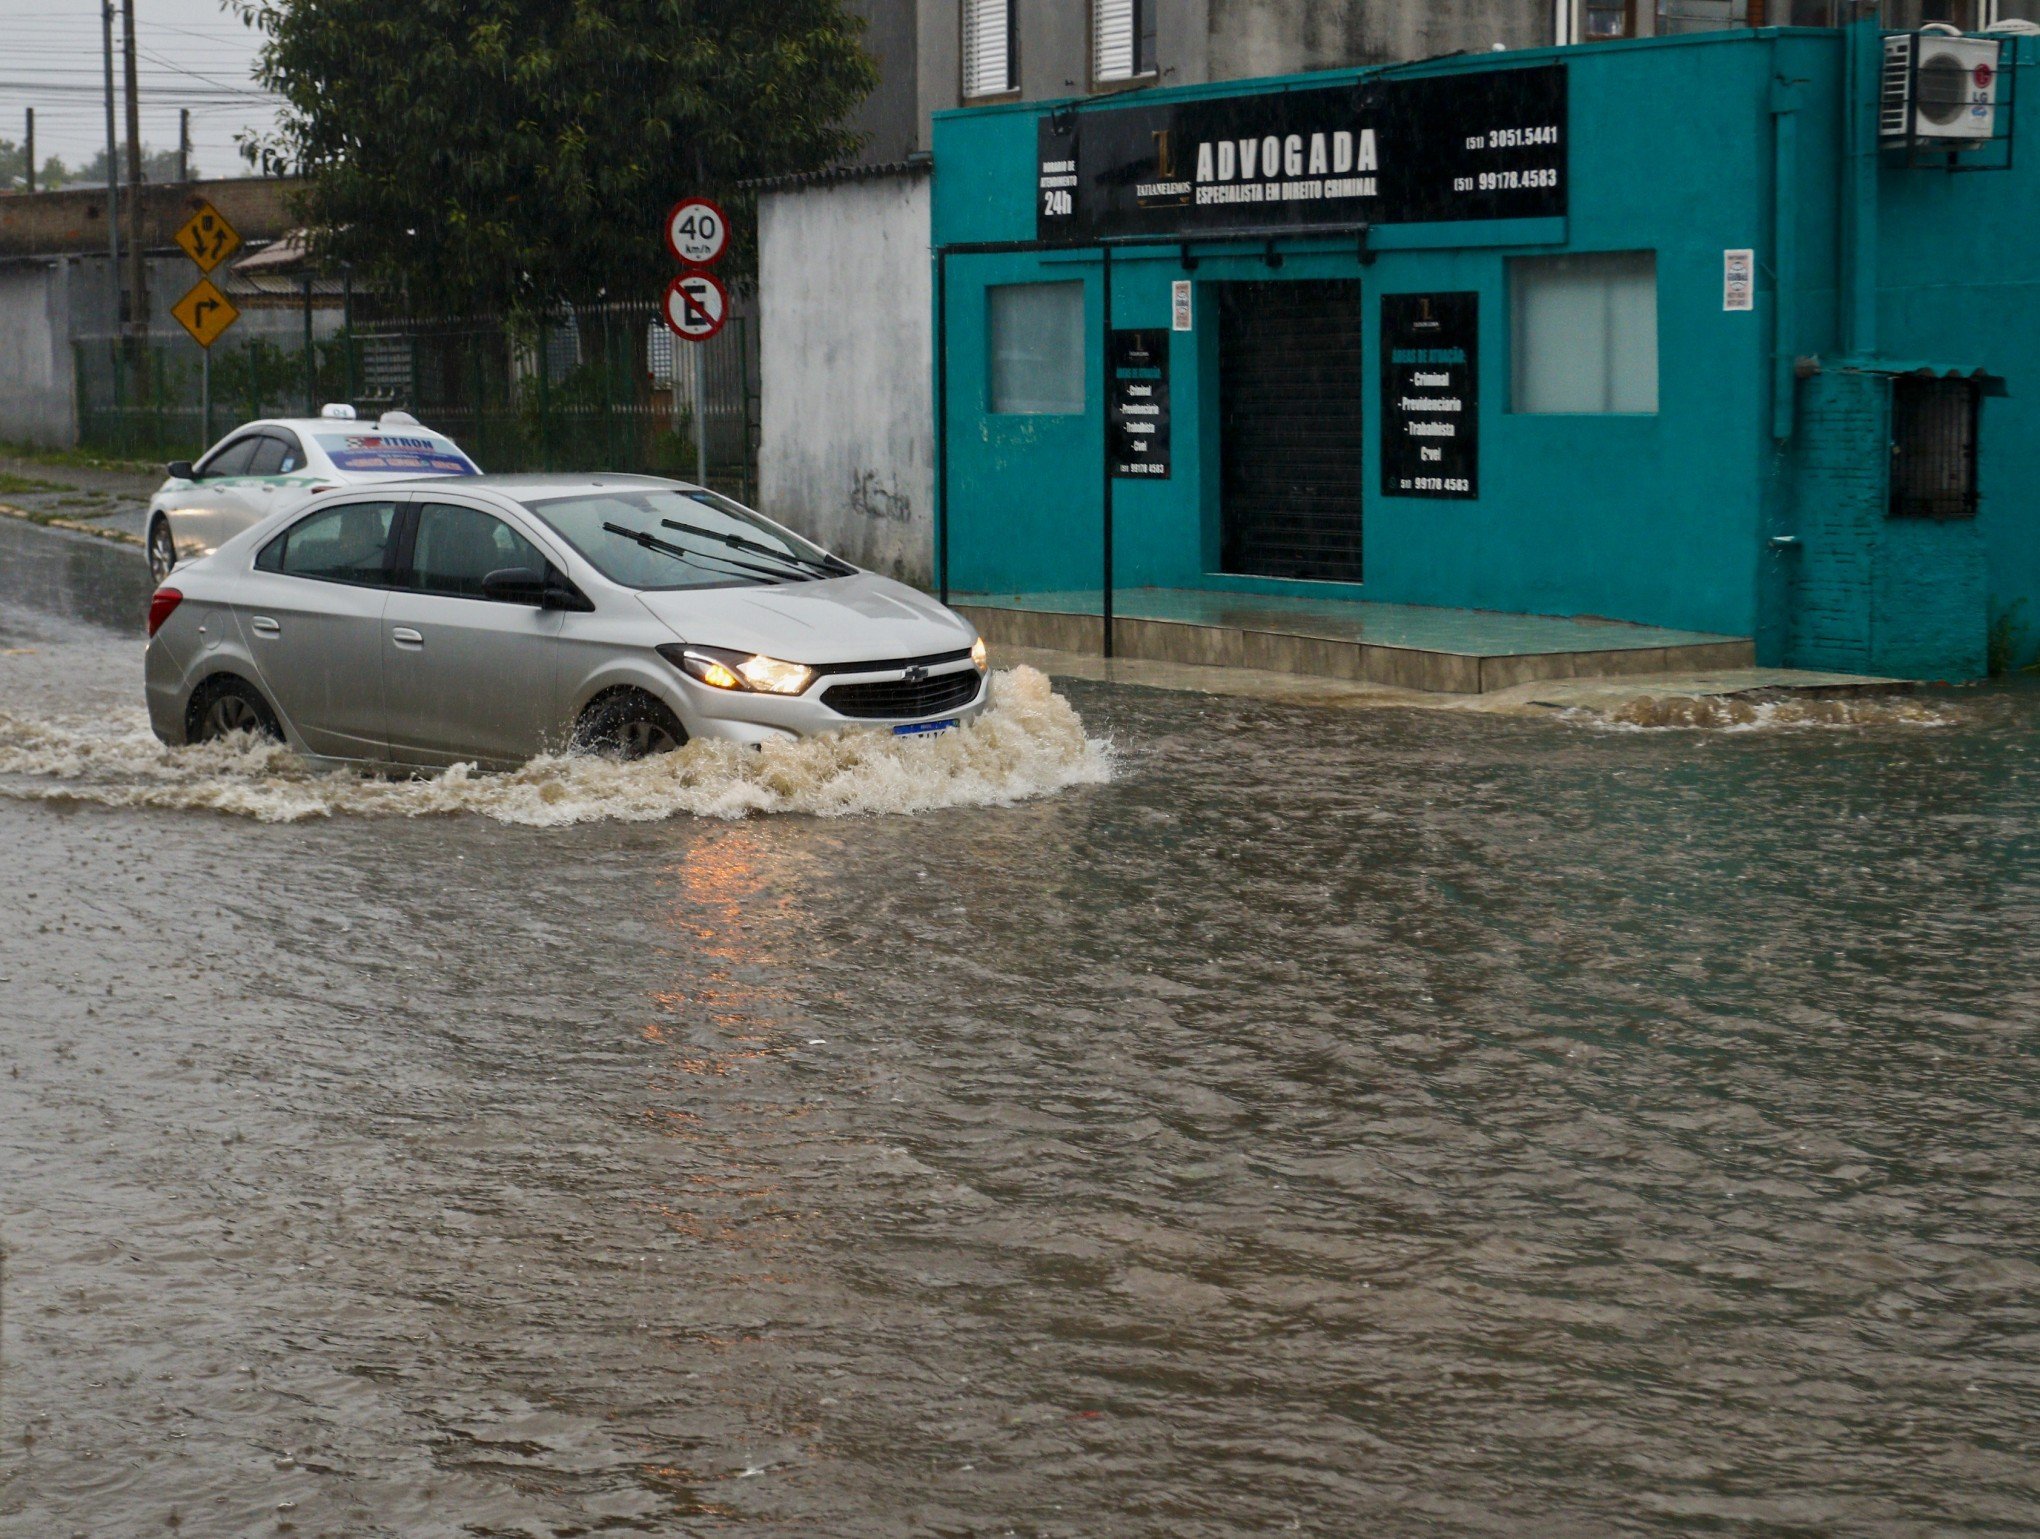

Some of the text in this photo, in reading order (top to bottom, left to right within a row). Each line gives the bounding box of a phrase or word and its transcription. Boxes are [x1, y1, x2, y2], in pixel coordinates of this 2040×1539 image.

[1466, 126, 1557, 149] (51) 3051.5441
[1196, 128, 1378, 183] ADVOGADA
[1196, 177, 1378, 205] ESPECIALISTA EM DIREITO CRIMINAL
[1454, 168, 1557, 191] (51) 99178.4583
[1044, 190, 1072, 216] 24h
[678, 215, 715, 240] 40
[685, 244, 711, 254] km/h
[684, 285, 706, 326] E
[1415, 477, 1442, 491] 99178
[1443, 478, 1469, 492] 4583
